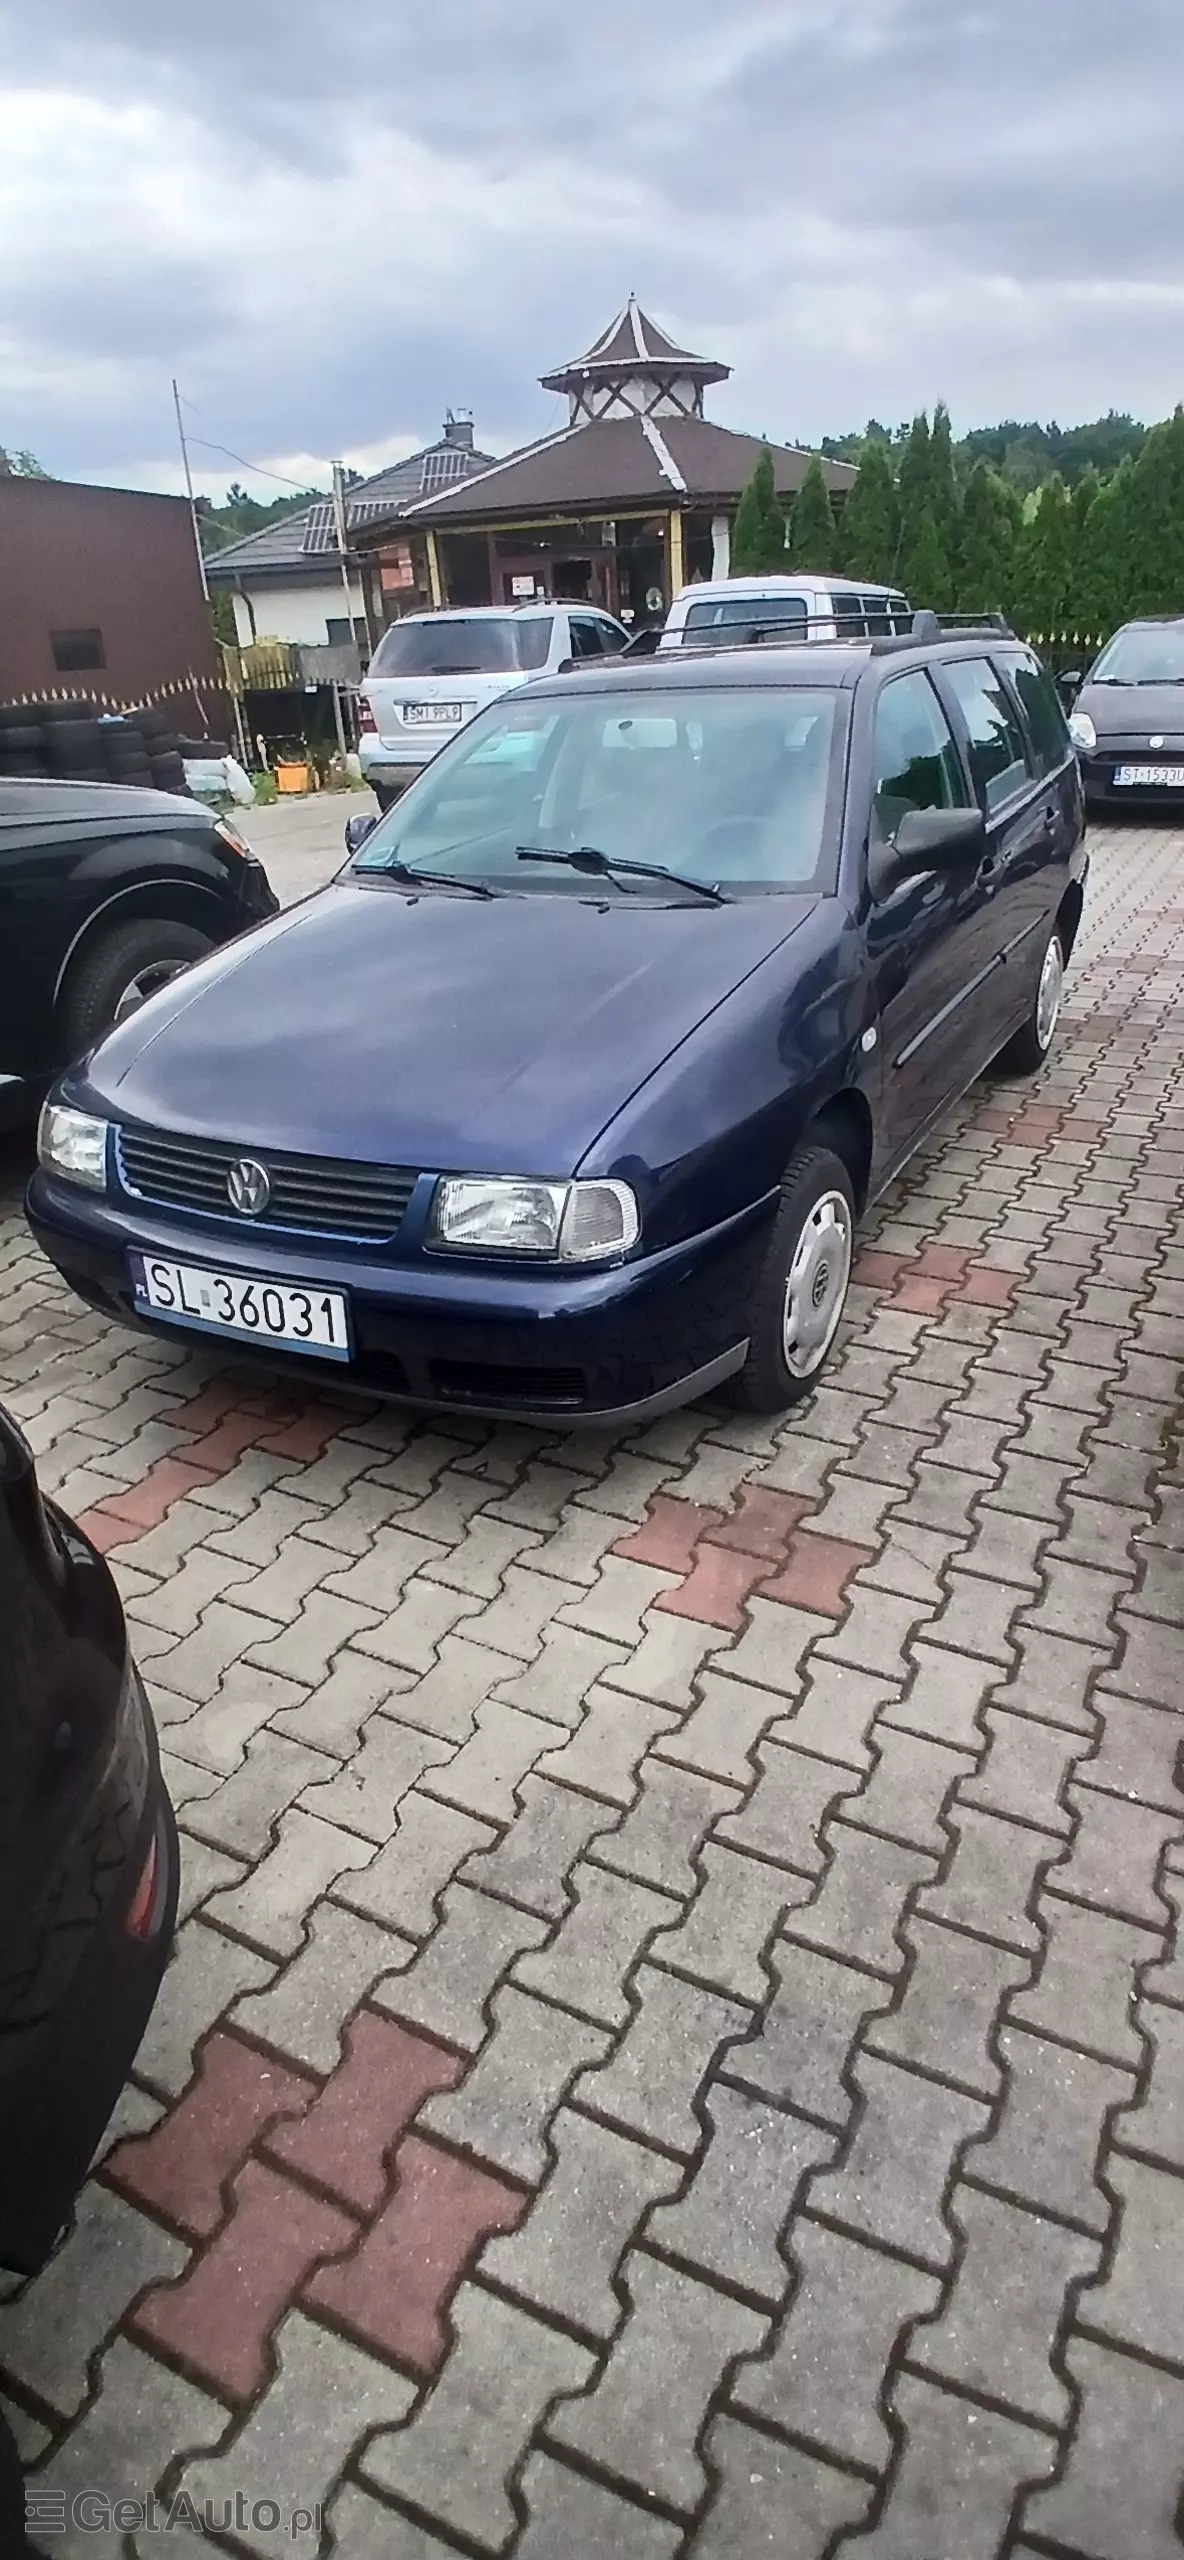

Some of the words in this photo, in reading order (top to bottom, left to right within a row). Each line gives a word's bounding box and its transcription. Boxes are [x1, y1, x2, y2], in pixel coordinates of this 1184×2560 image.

[1124, 768, 1139, 781] ST
[135, 1283, 148, 1297] PL
[151, 1263, 201, 1315] SL
[213, 1278, 335, 1342] 36031
